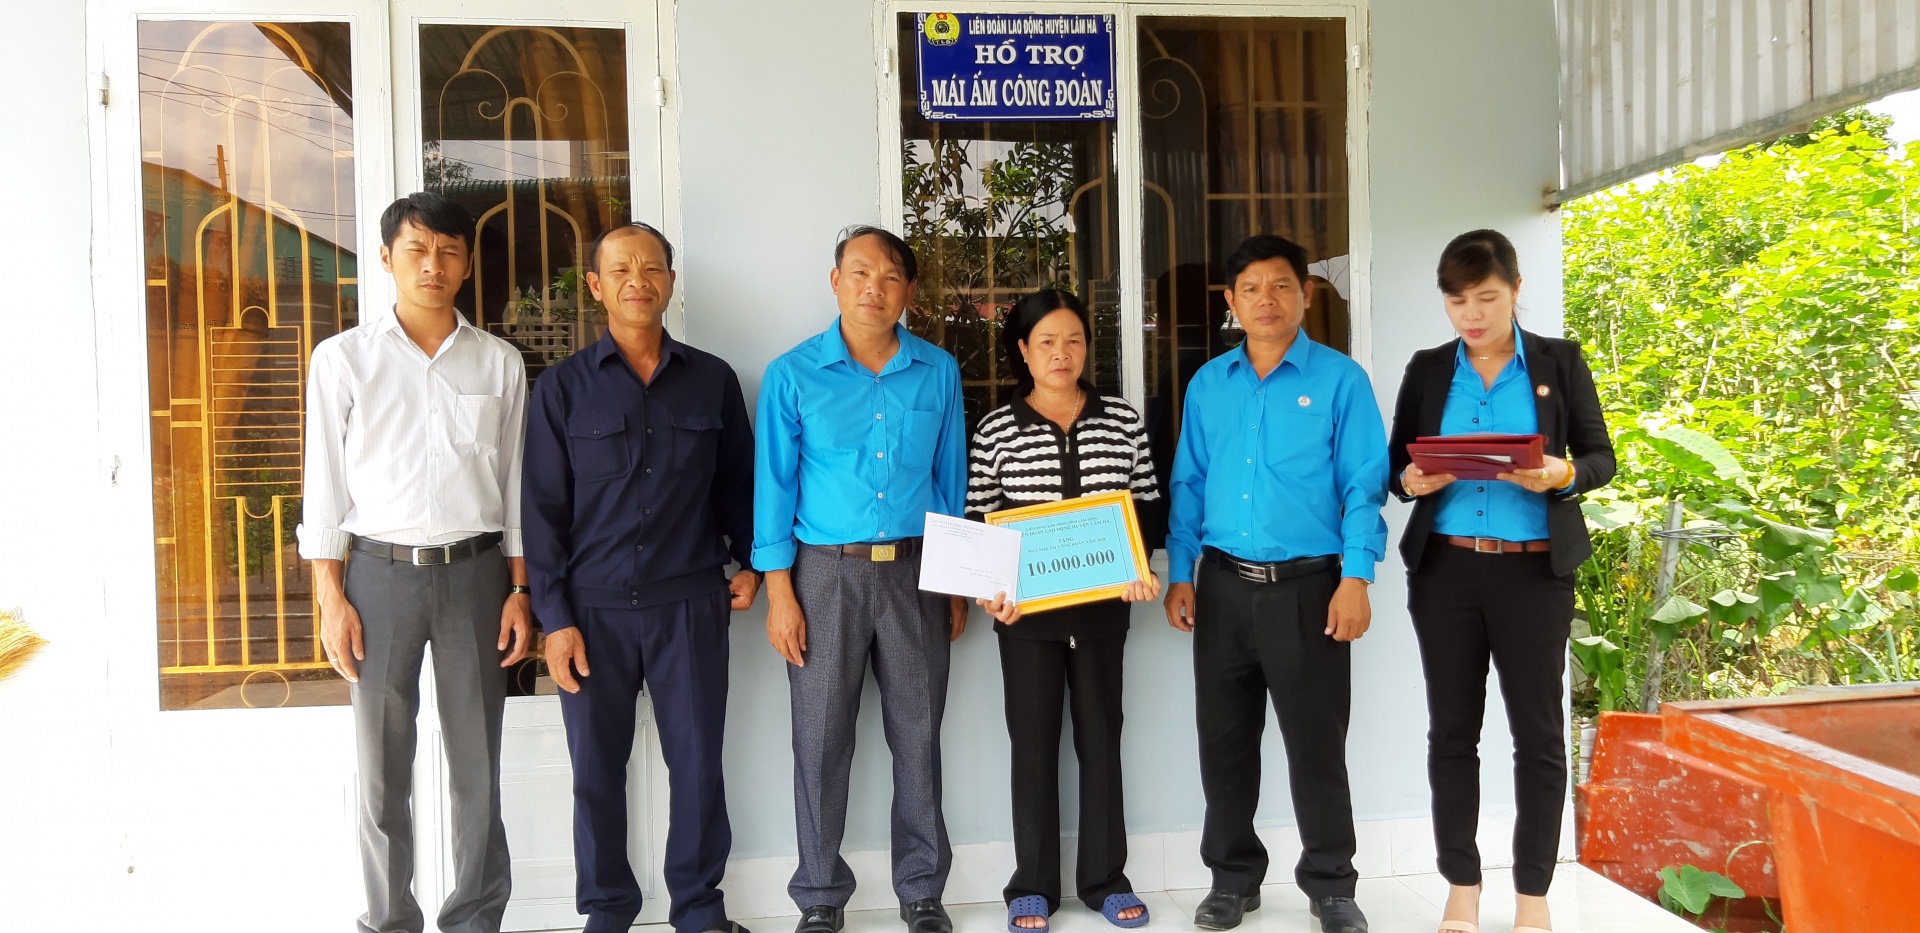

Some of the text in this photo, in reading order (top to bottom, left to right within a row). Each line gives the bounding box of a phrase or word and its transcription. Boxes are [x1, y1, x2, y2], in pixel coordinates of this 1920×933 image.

[969, 15, 1097, 39] LIÊN ĐOÀN LAO ĐỘNG HUYỆN LÂM HÀ
[974, 38, 1085, 70] HỖ TRỢ
[931, 70, 1102, 107] MÁI ẤM CÔNG ĐOÀN
[1027, 549, 1115, 577] 10.000.000
